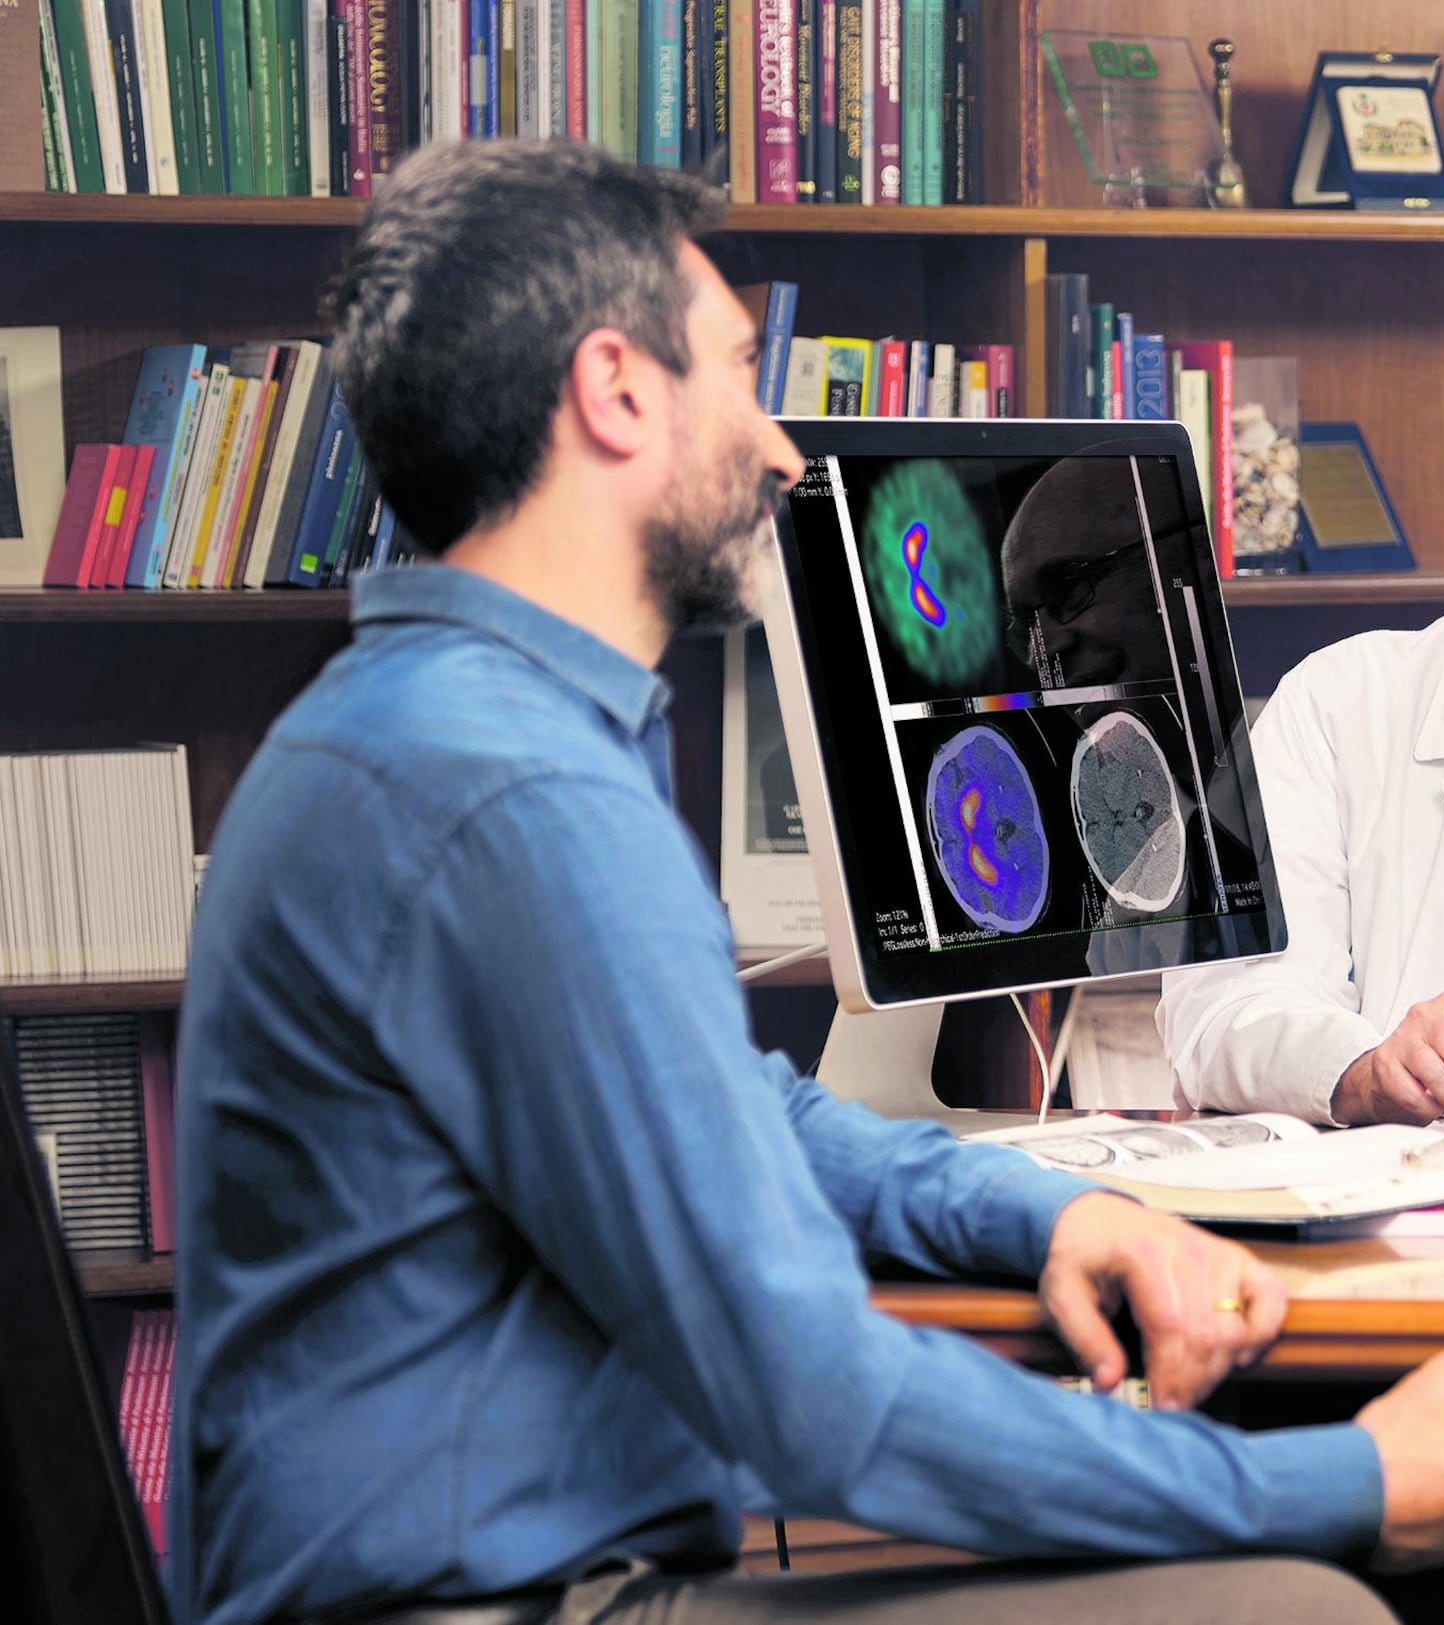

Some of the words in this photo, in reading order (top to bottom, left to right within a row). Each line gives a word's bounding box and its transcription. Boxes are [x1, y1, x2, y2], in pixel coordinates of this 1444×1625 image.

[713, 40, 727, 134] TRANSPLANTS
[760, 0, 780, 117] EUROLOGY
[1135, 348, 1163, 418] 2013
